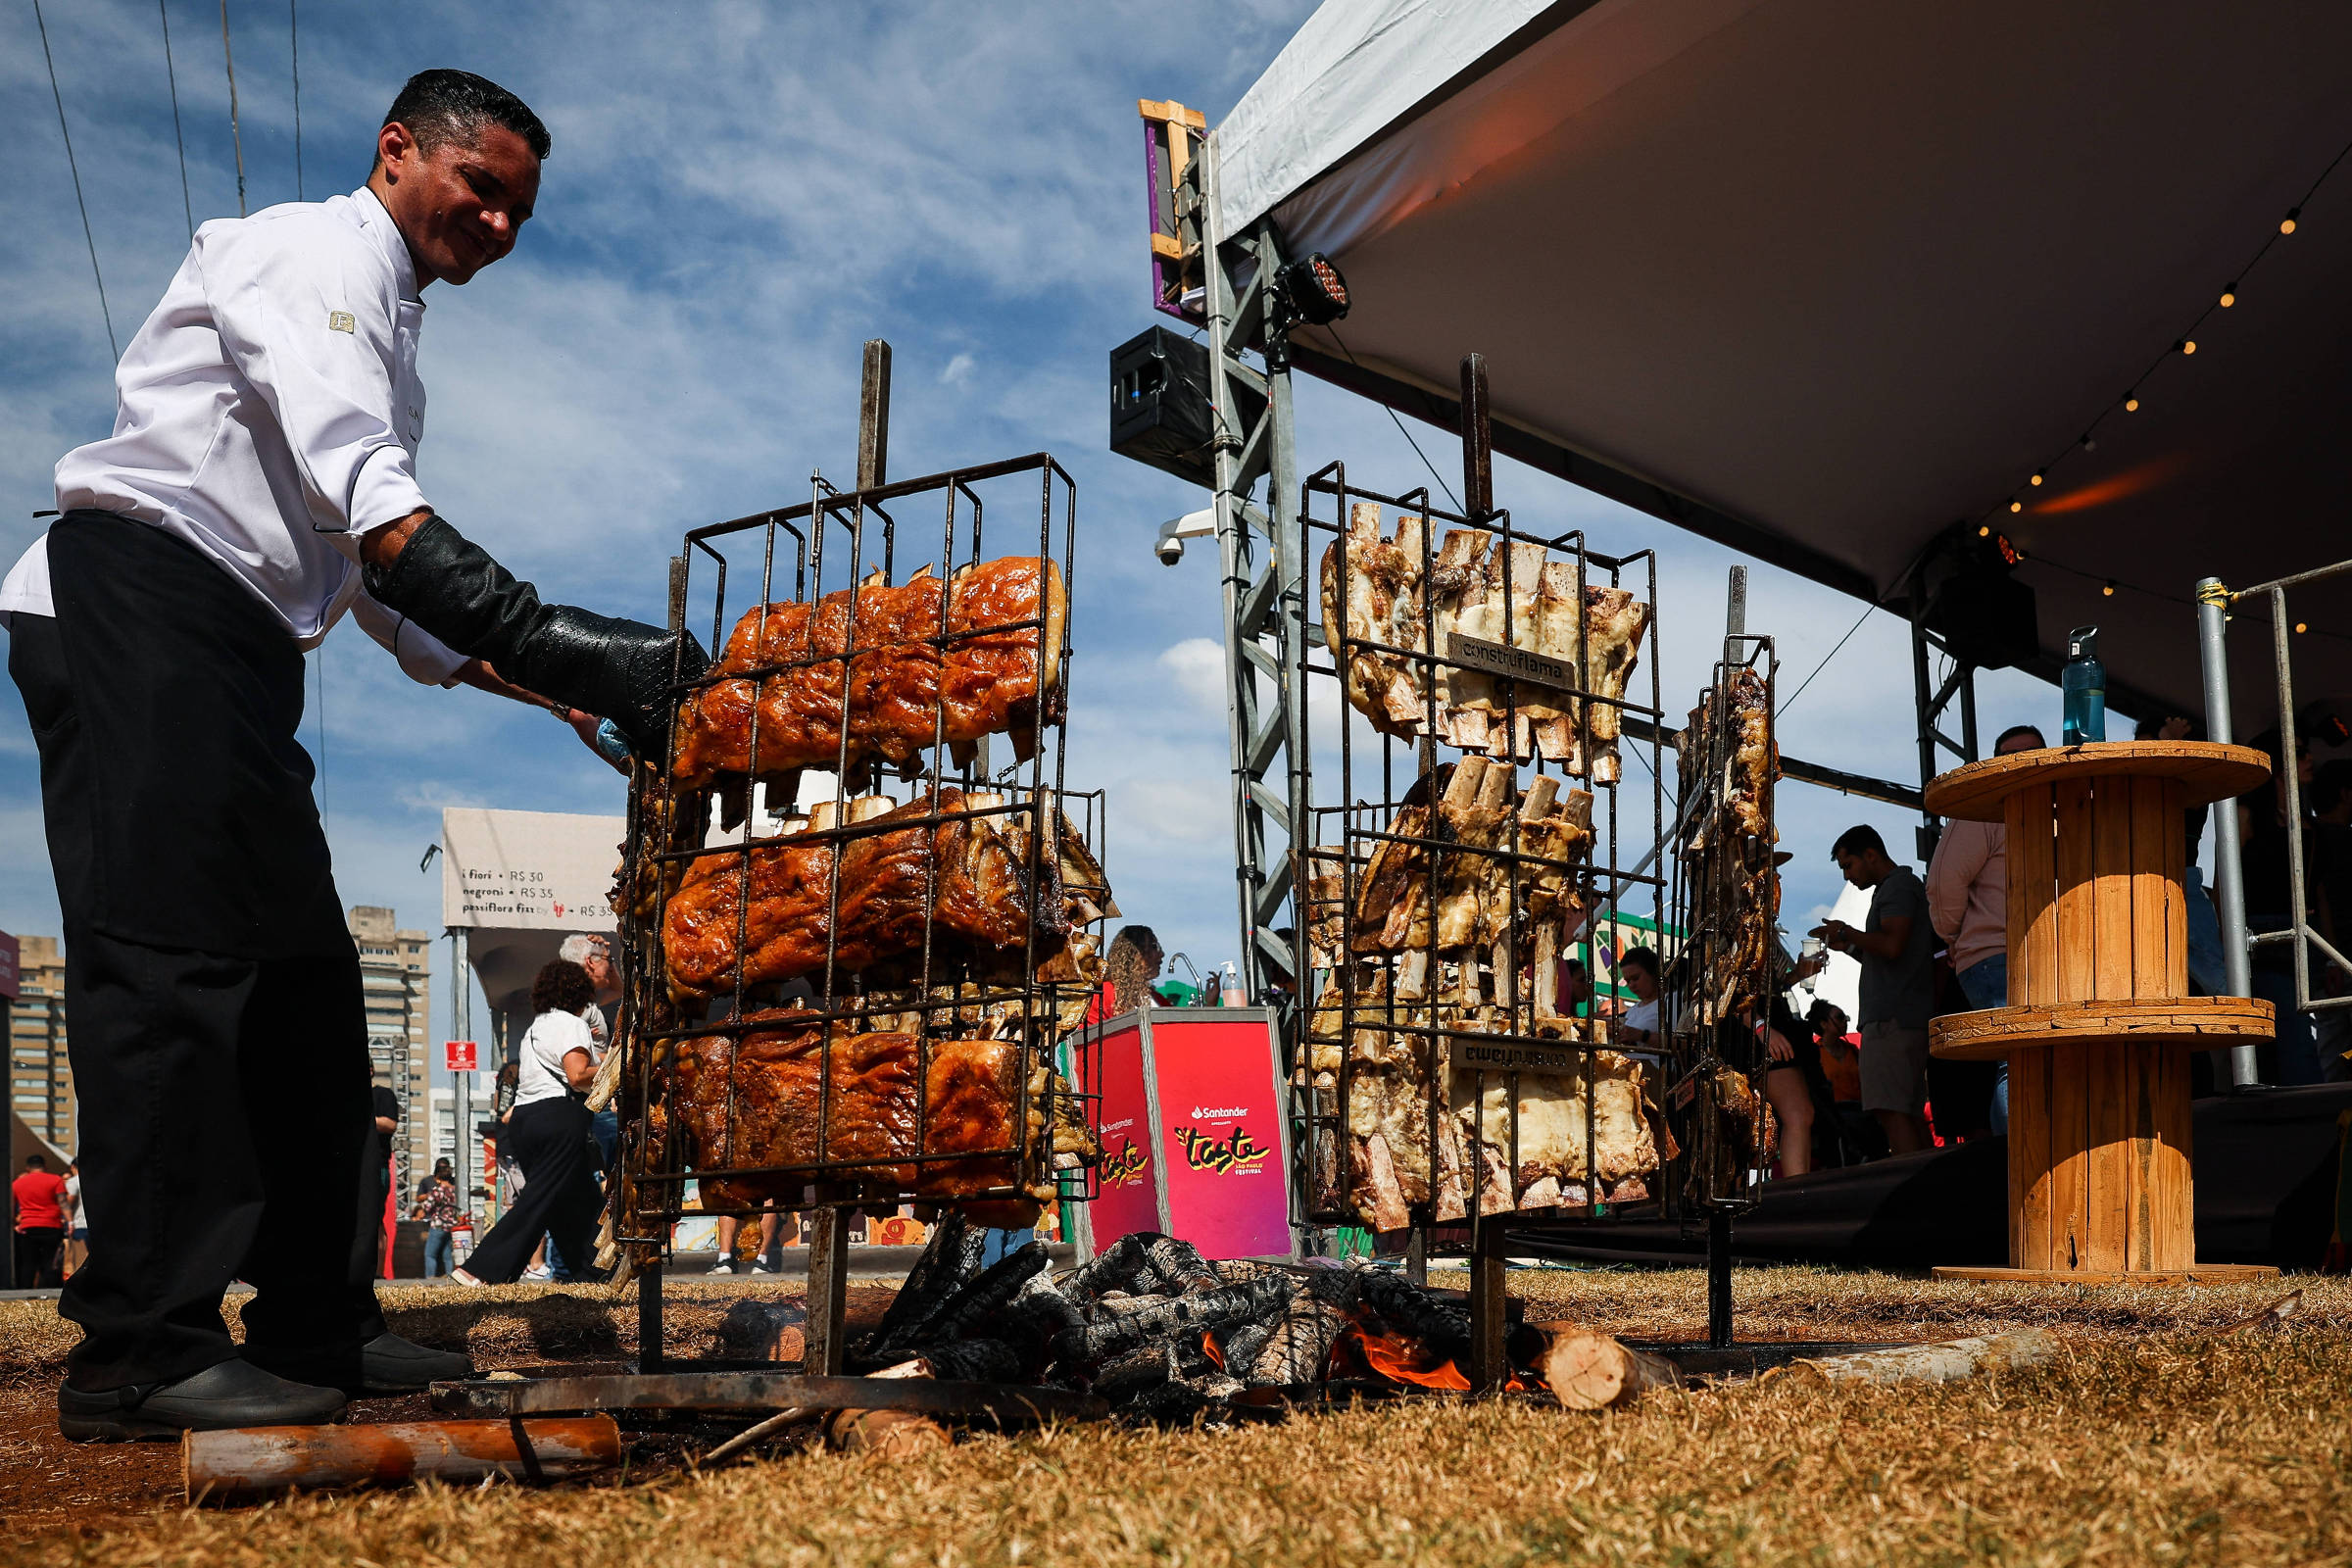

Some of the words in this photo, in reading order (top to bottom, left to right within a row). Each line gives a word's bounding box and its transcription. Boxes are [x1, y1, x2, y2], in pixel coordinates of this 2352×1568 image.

[1462, 643, 1562, 678] construflama
[469, 868, 492, 880] fiori
[529, 871, 544, 883] 30
[463, 887, 505, 899] negroni
[539, 888, 554, 899] 35
[463, 902, 514, 914] passiflora
[1202, 1106, 1249, 1119] Santander
[1185, 1126, 1271, 1176] taste
